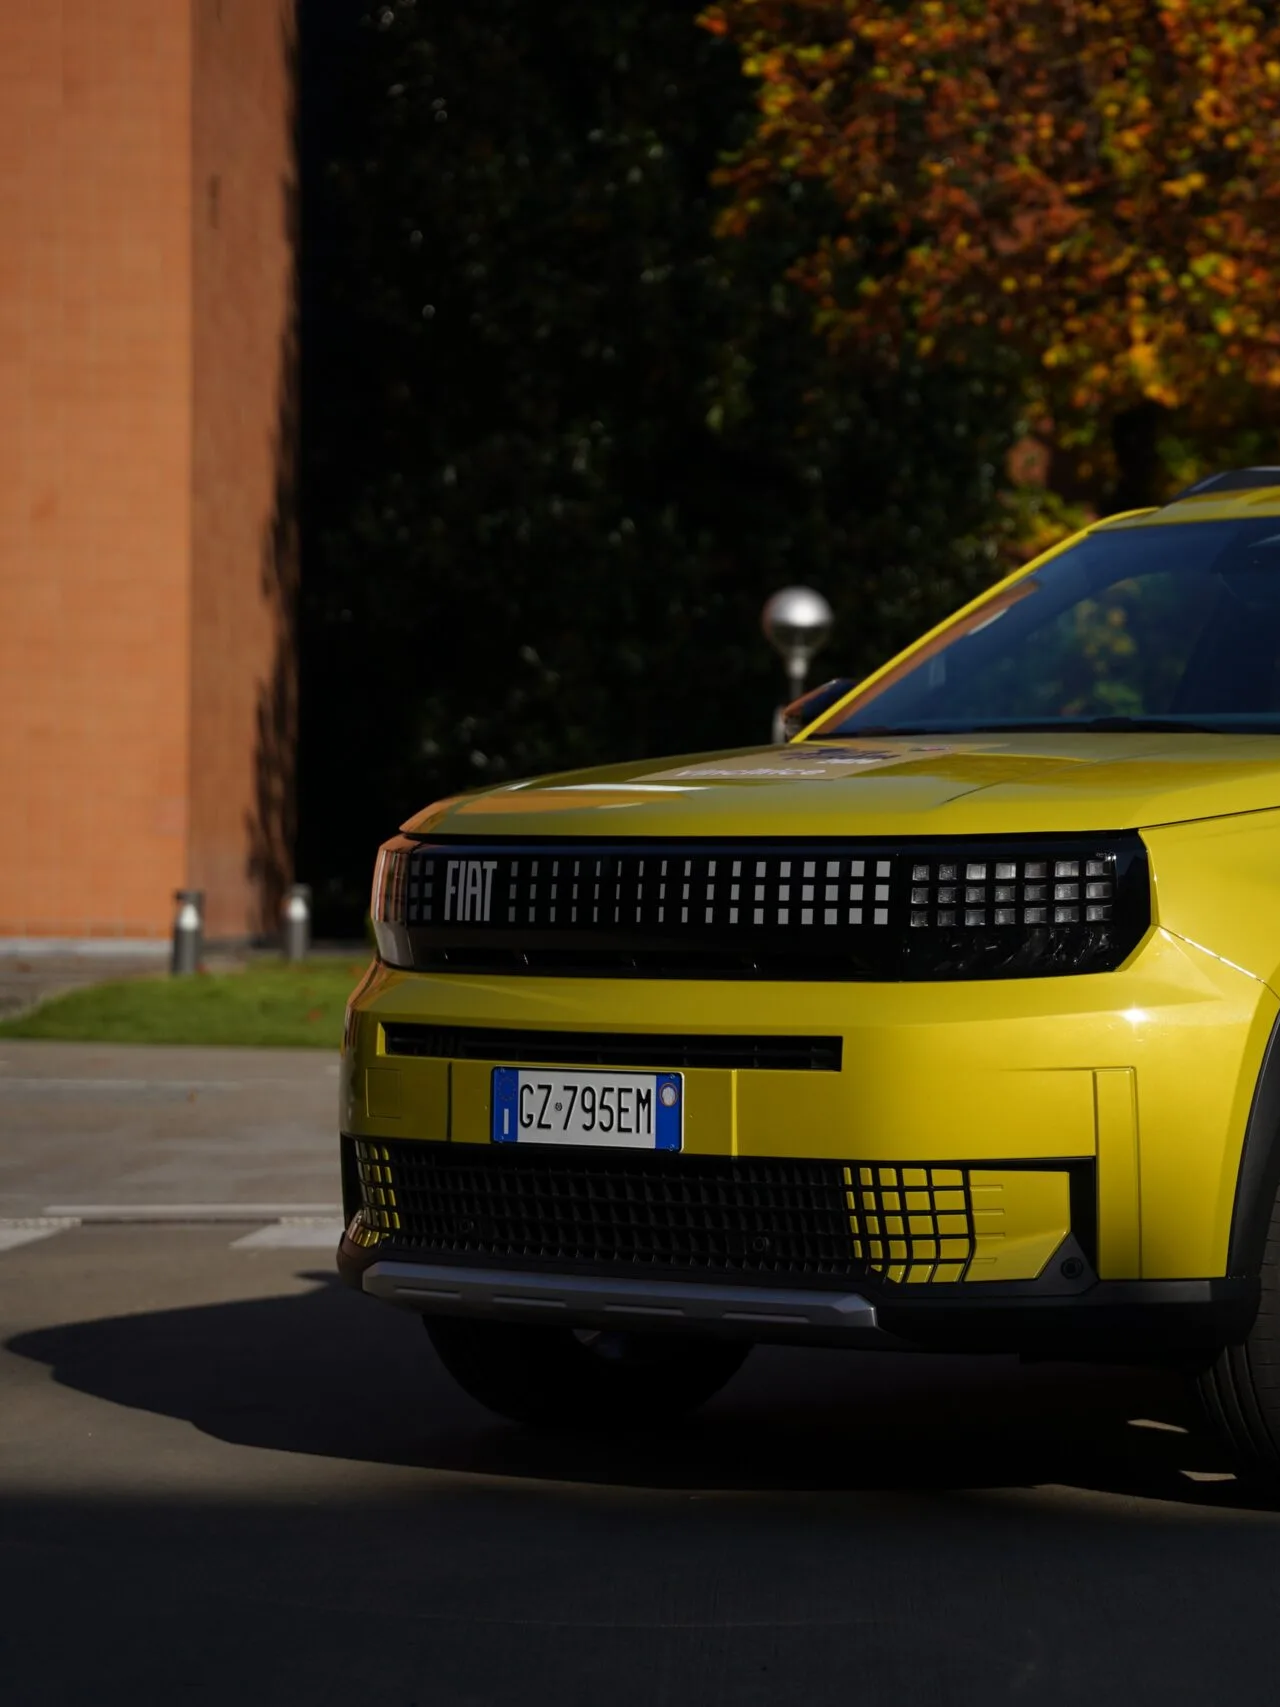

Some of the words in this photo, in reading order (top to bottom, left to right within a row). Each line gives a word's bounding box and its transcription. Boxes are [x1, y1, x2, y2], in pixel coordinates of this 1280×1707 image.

[444, 860, 498, 922] FIAT
[519, 1084, 552, 1129] GZ
[563, 1086, 652, 1134] 795EM
